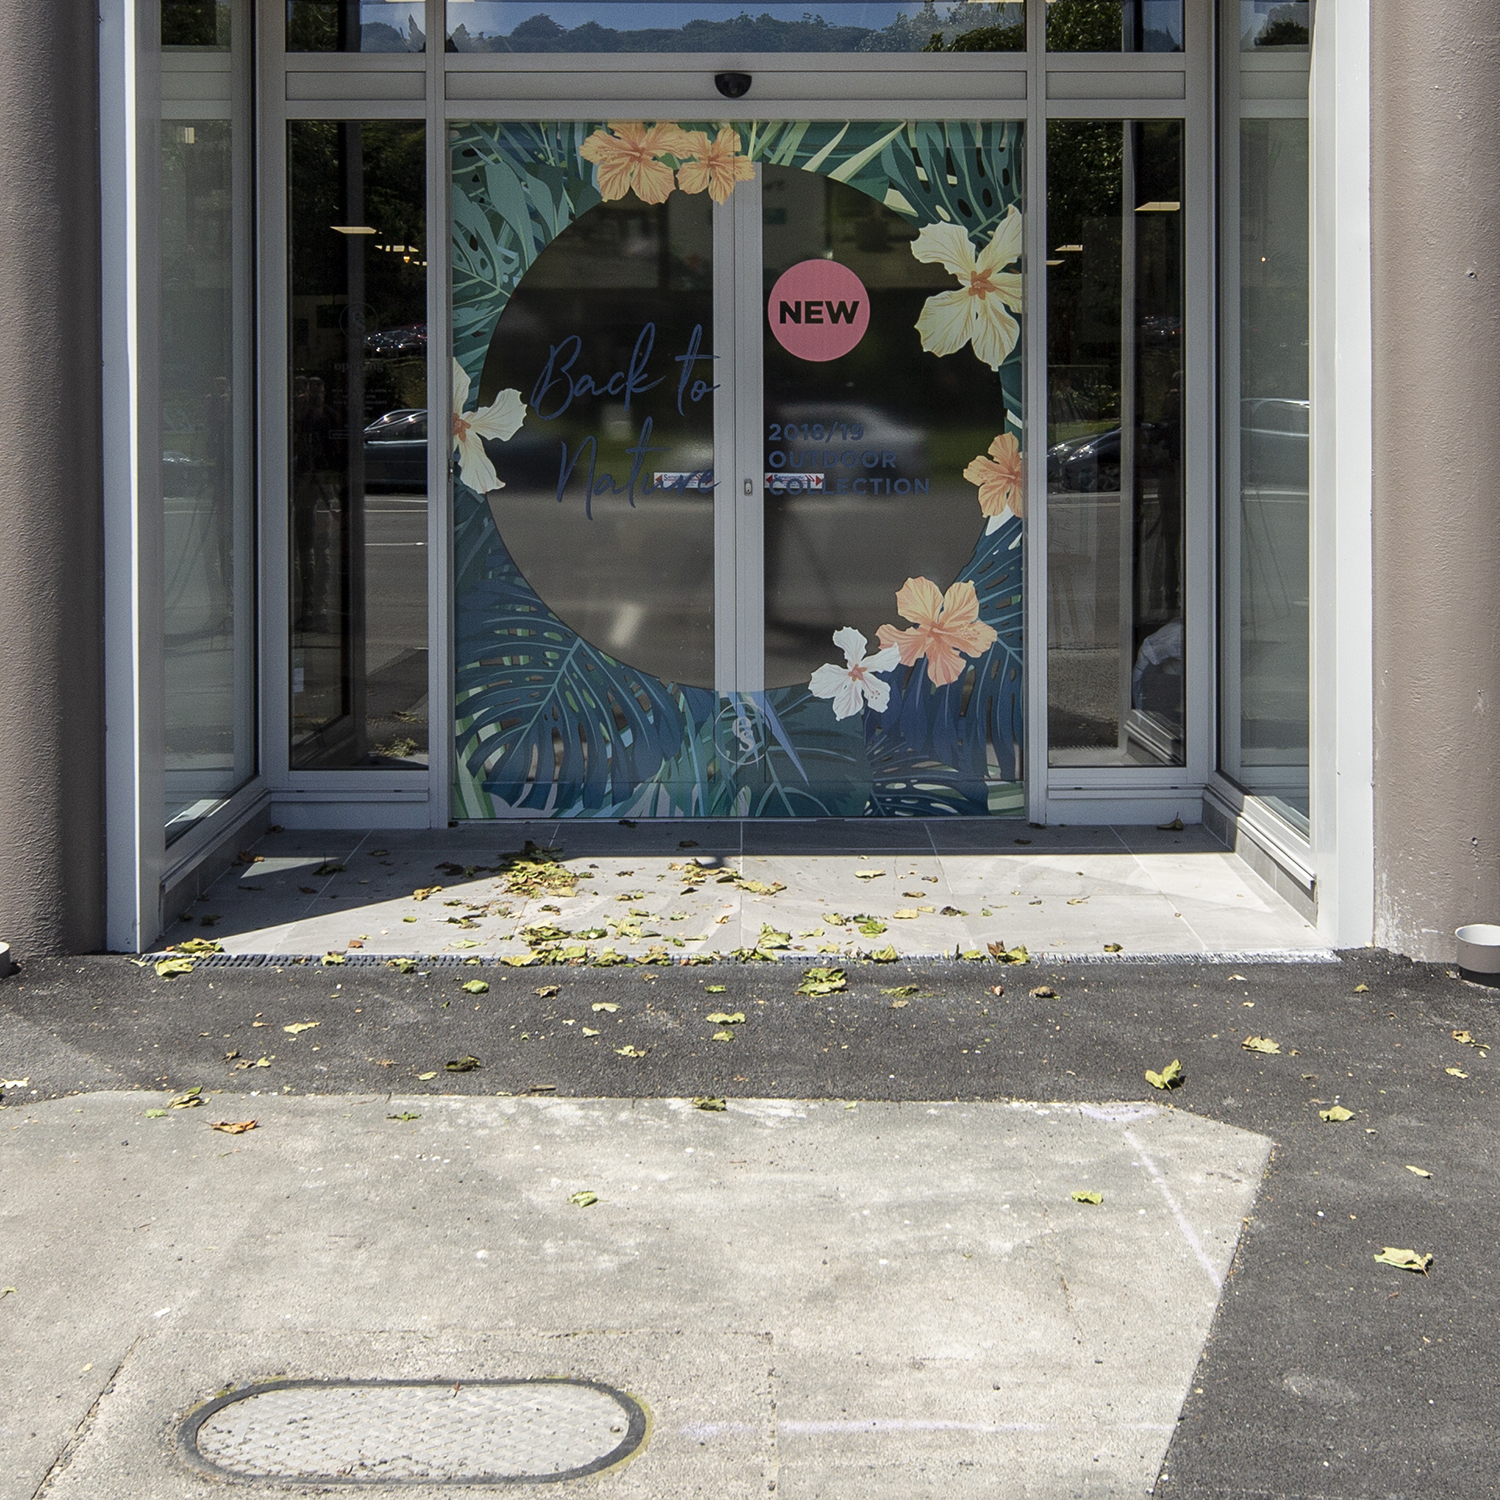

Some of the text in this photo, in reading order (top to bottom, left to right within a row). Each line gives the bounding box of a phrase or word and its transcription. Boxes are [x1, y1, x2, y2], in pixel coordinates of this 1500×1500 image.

[779, 300, 860, 325] NEW
[530, 322, 721, 420] Back to
[768, 421, 865, 444] 2018/19
[556, 416, 722, 521] Nature
[768, 450, 897, 469] OUTDOOR
[768, 477, 930, 496] COLLECTION
